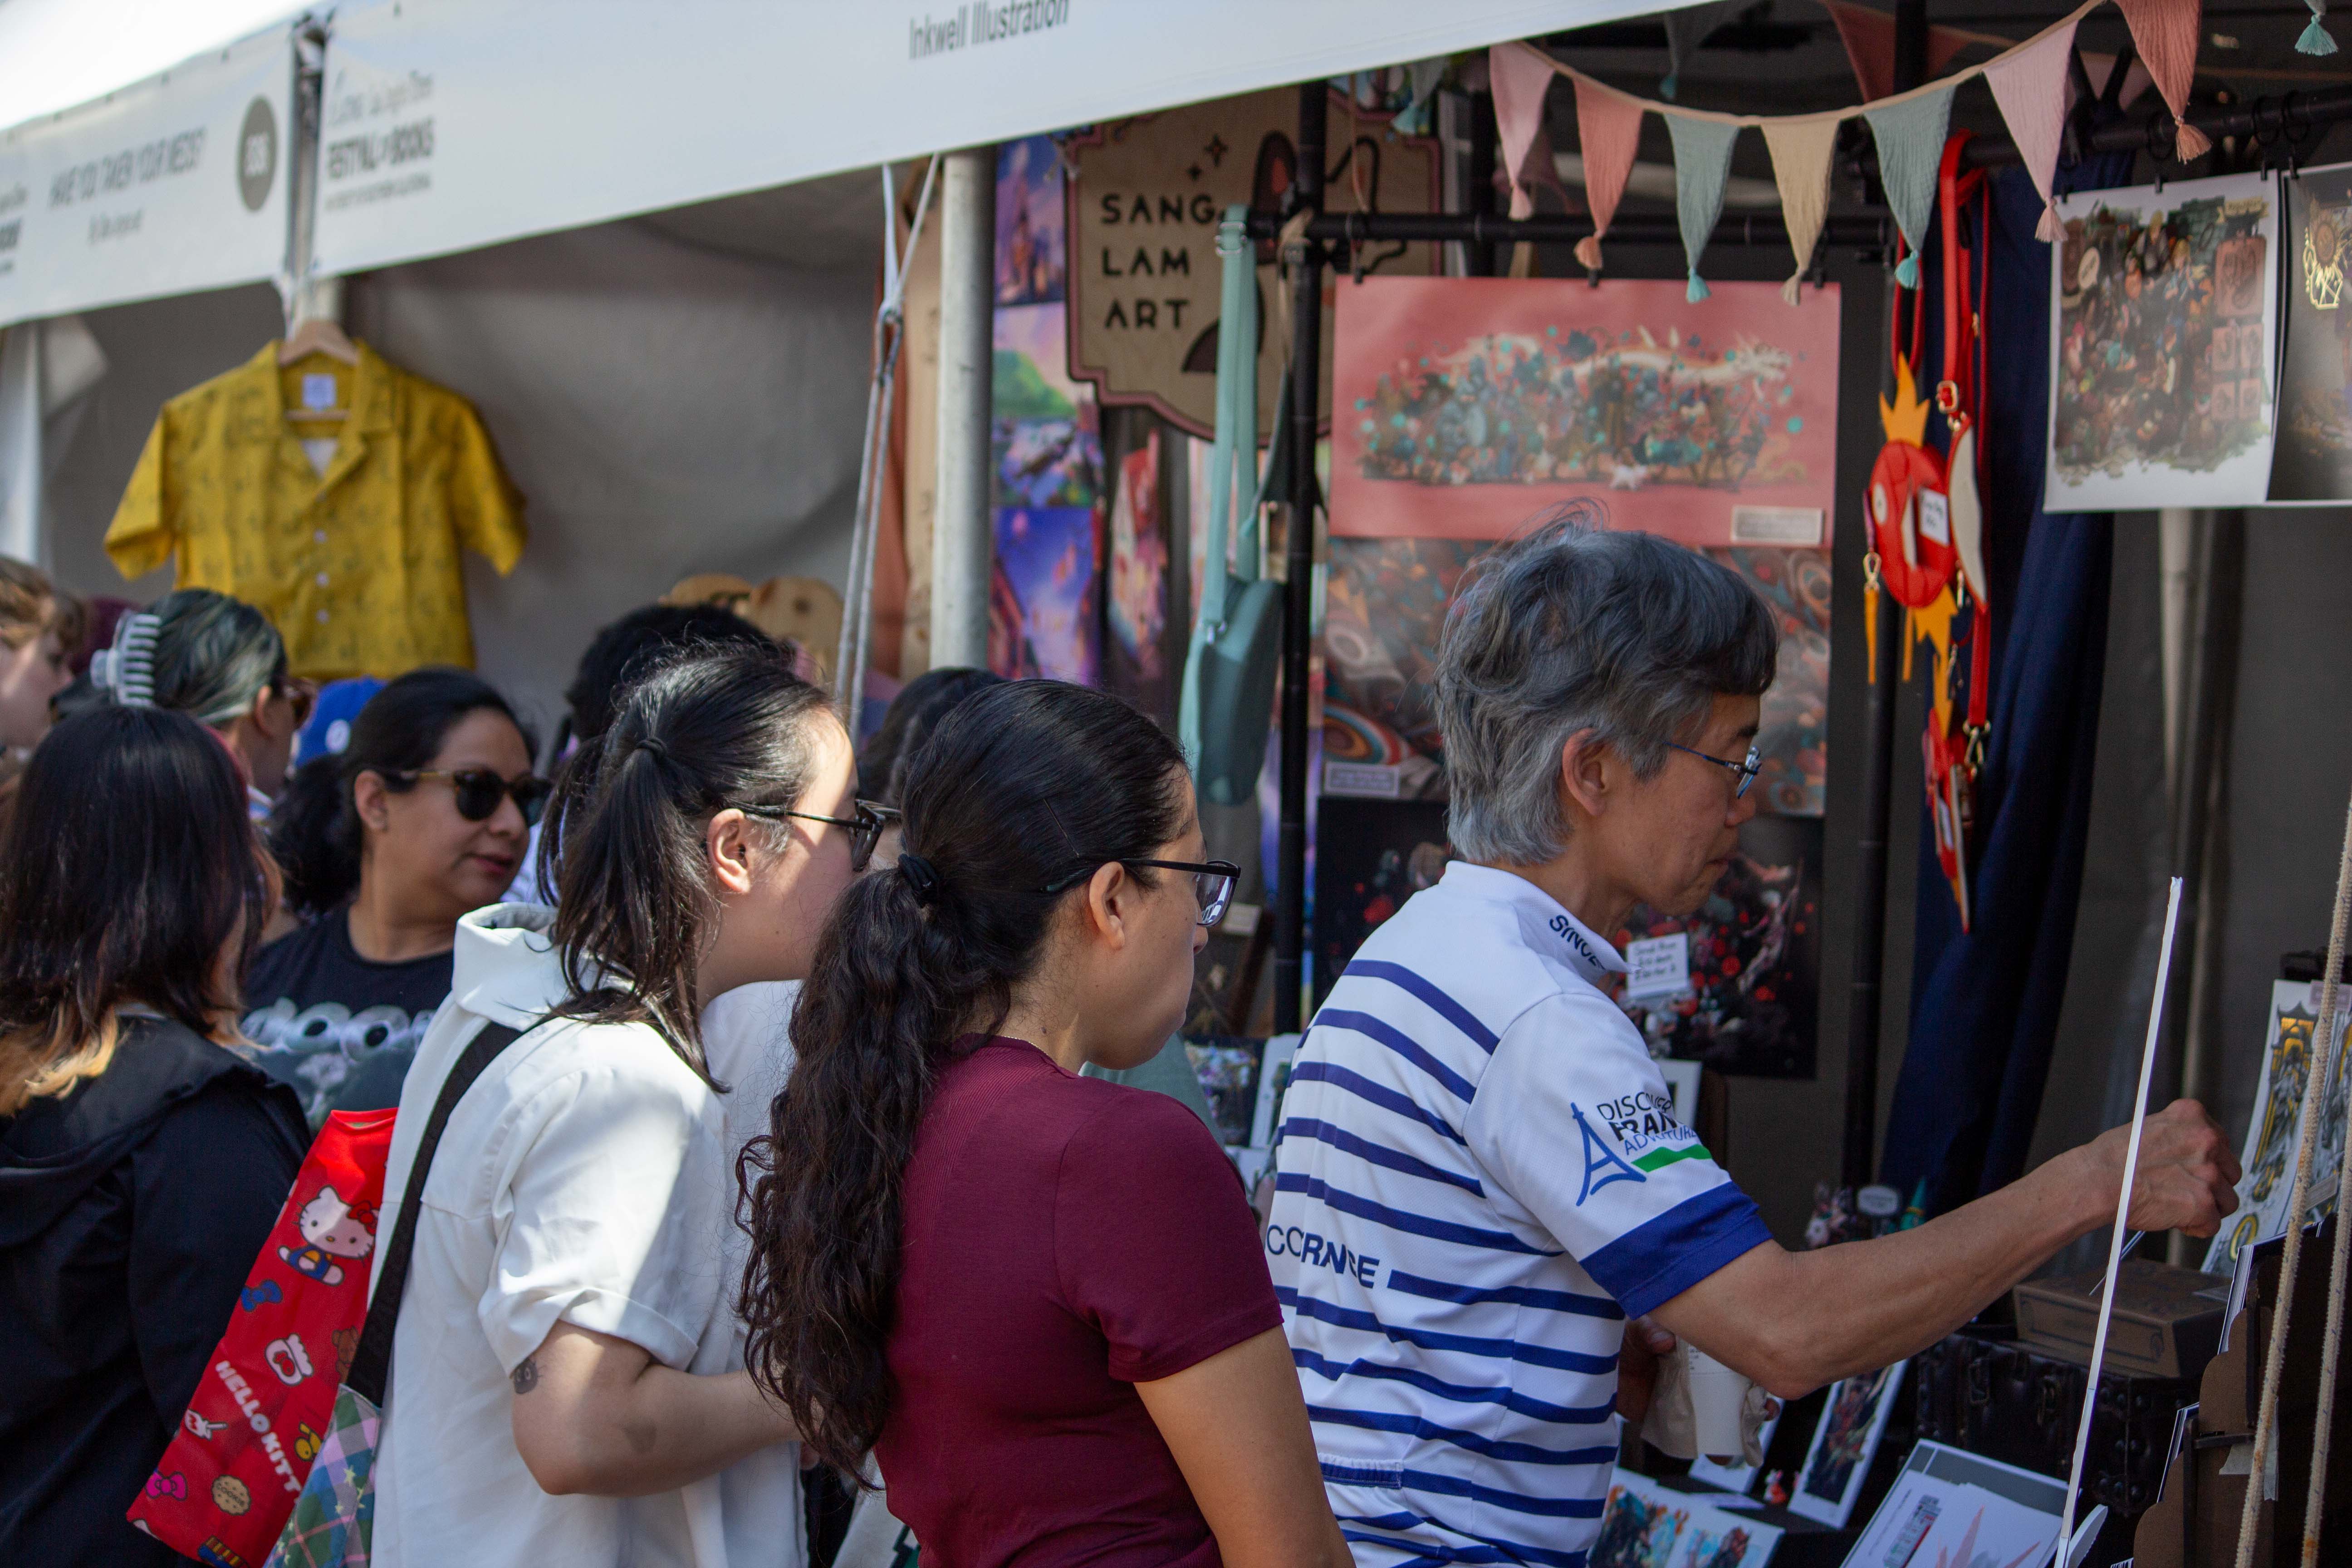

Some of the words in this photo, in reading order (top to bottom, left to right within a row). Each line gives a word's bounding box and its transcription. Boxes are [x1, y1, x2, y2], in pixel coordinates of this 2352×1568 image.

[909, 5, 967, 59] Inkwell
[972, 0, 1069, 44] Illustration
[1102, 194, 1215, 224] SANG
[1102, 247, 1190, 275] LAM
[1104, 299, 1191, 329] ART
[216, 1360, 270, 1433] HELLO
[261, 1432, 302, 1493] KITT
